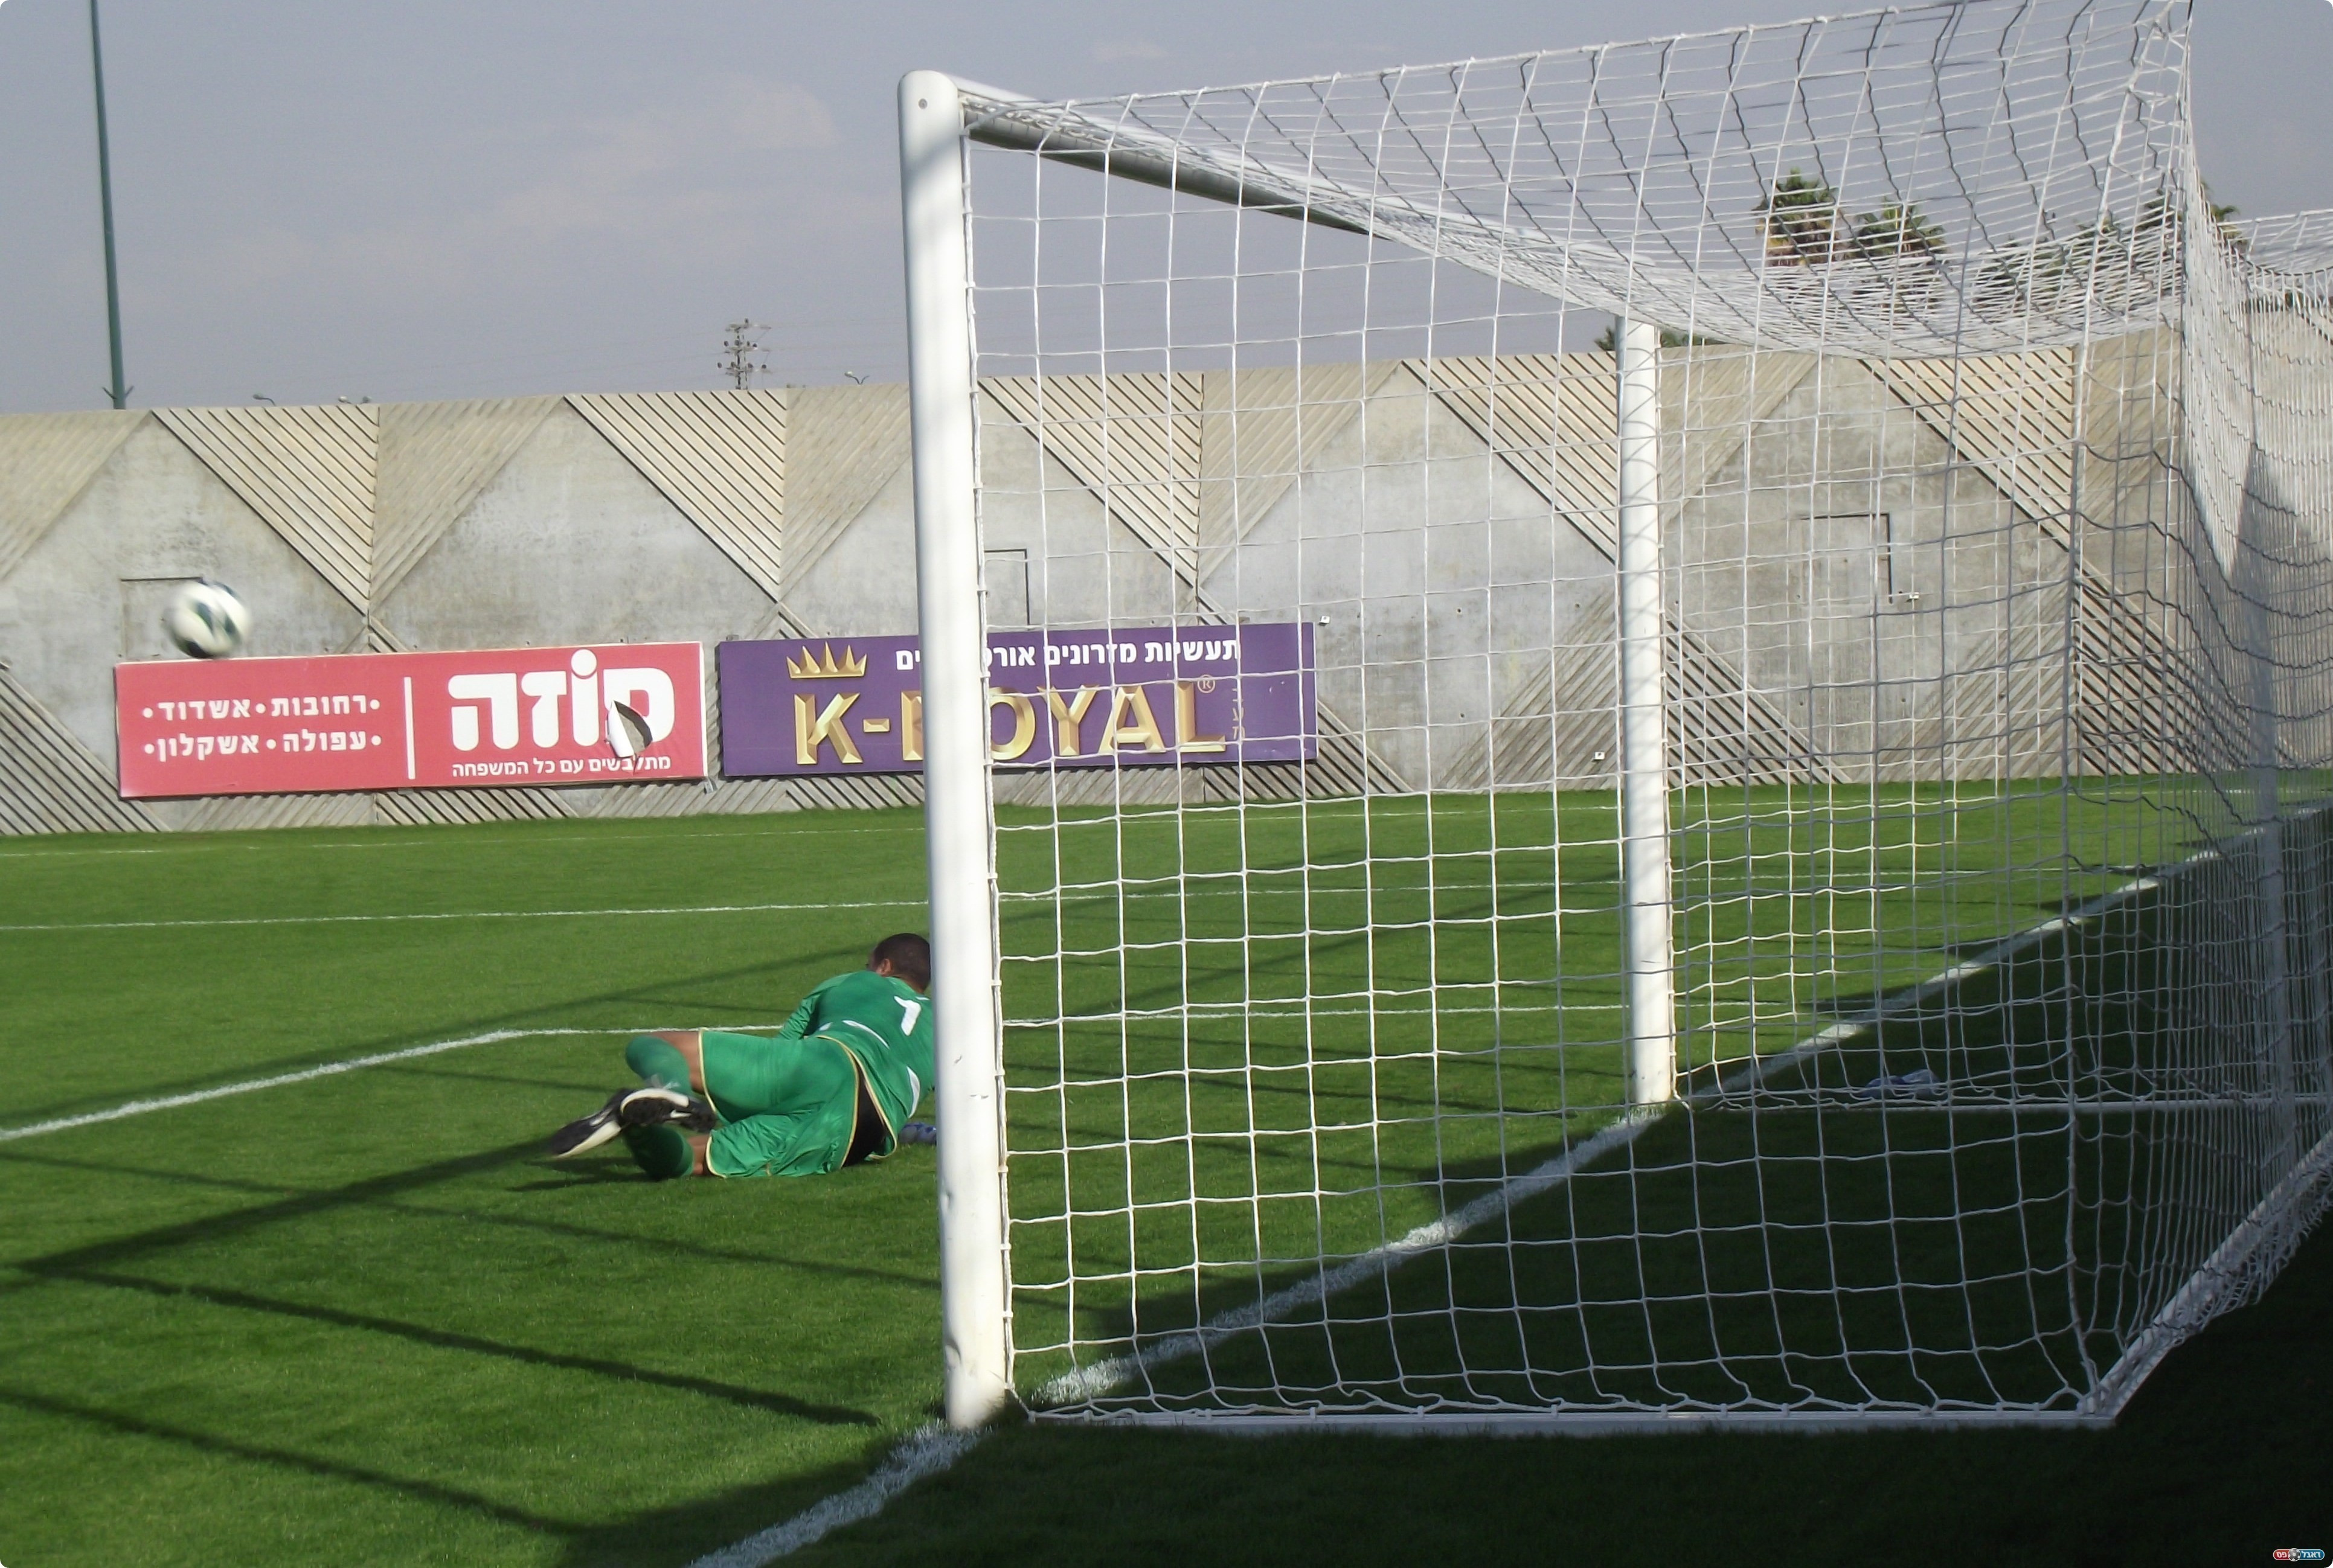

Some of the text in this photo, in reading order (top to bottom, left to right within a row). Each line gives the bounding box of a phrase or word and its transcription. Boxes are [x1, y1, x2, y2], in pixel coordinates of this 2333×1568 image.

[1045, 642, 1137, 665] מזרונים
[1145, 640, 1237, 662] תעשיות
[158, 695, 367, 721] רחובות אשדוד
[157, 729, 367, 762] עפולה אשקלון
[452, 761, 529, 777] המשפחה
[533, 757, 556, 773] כל
[559, 759, 584, 773] עם
